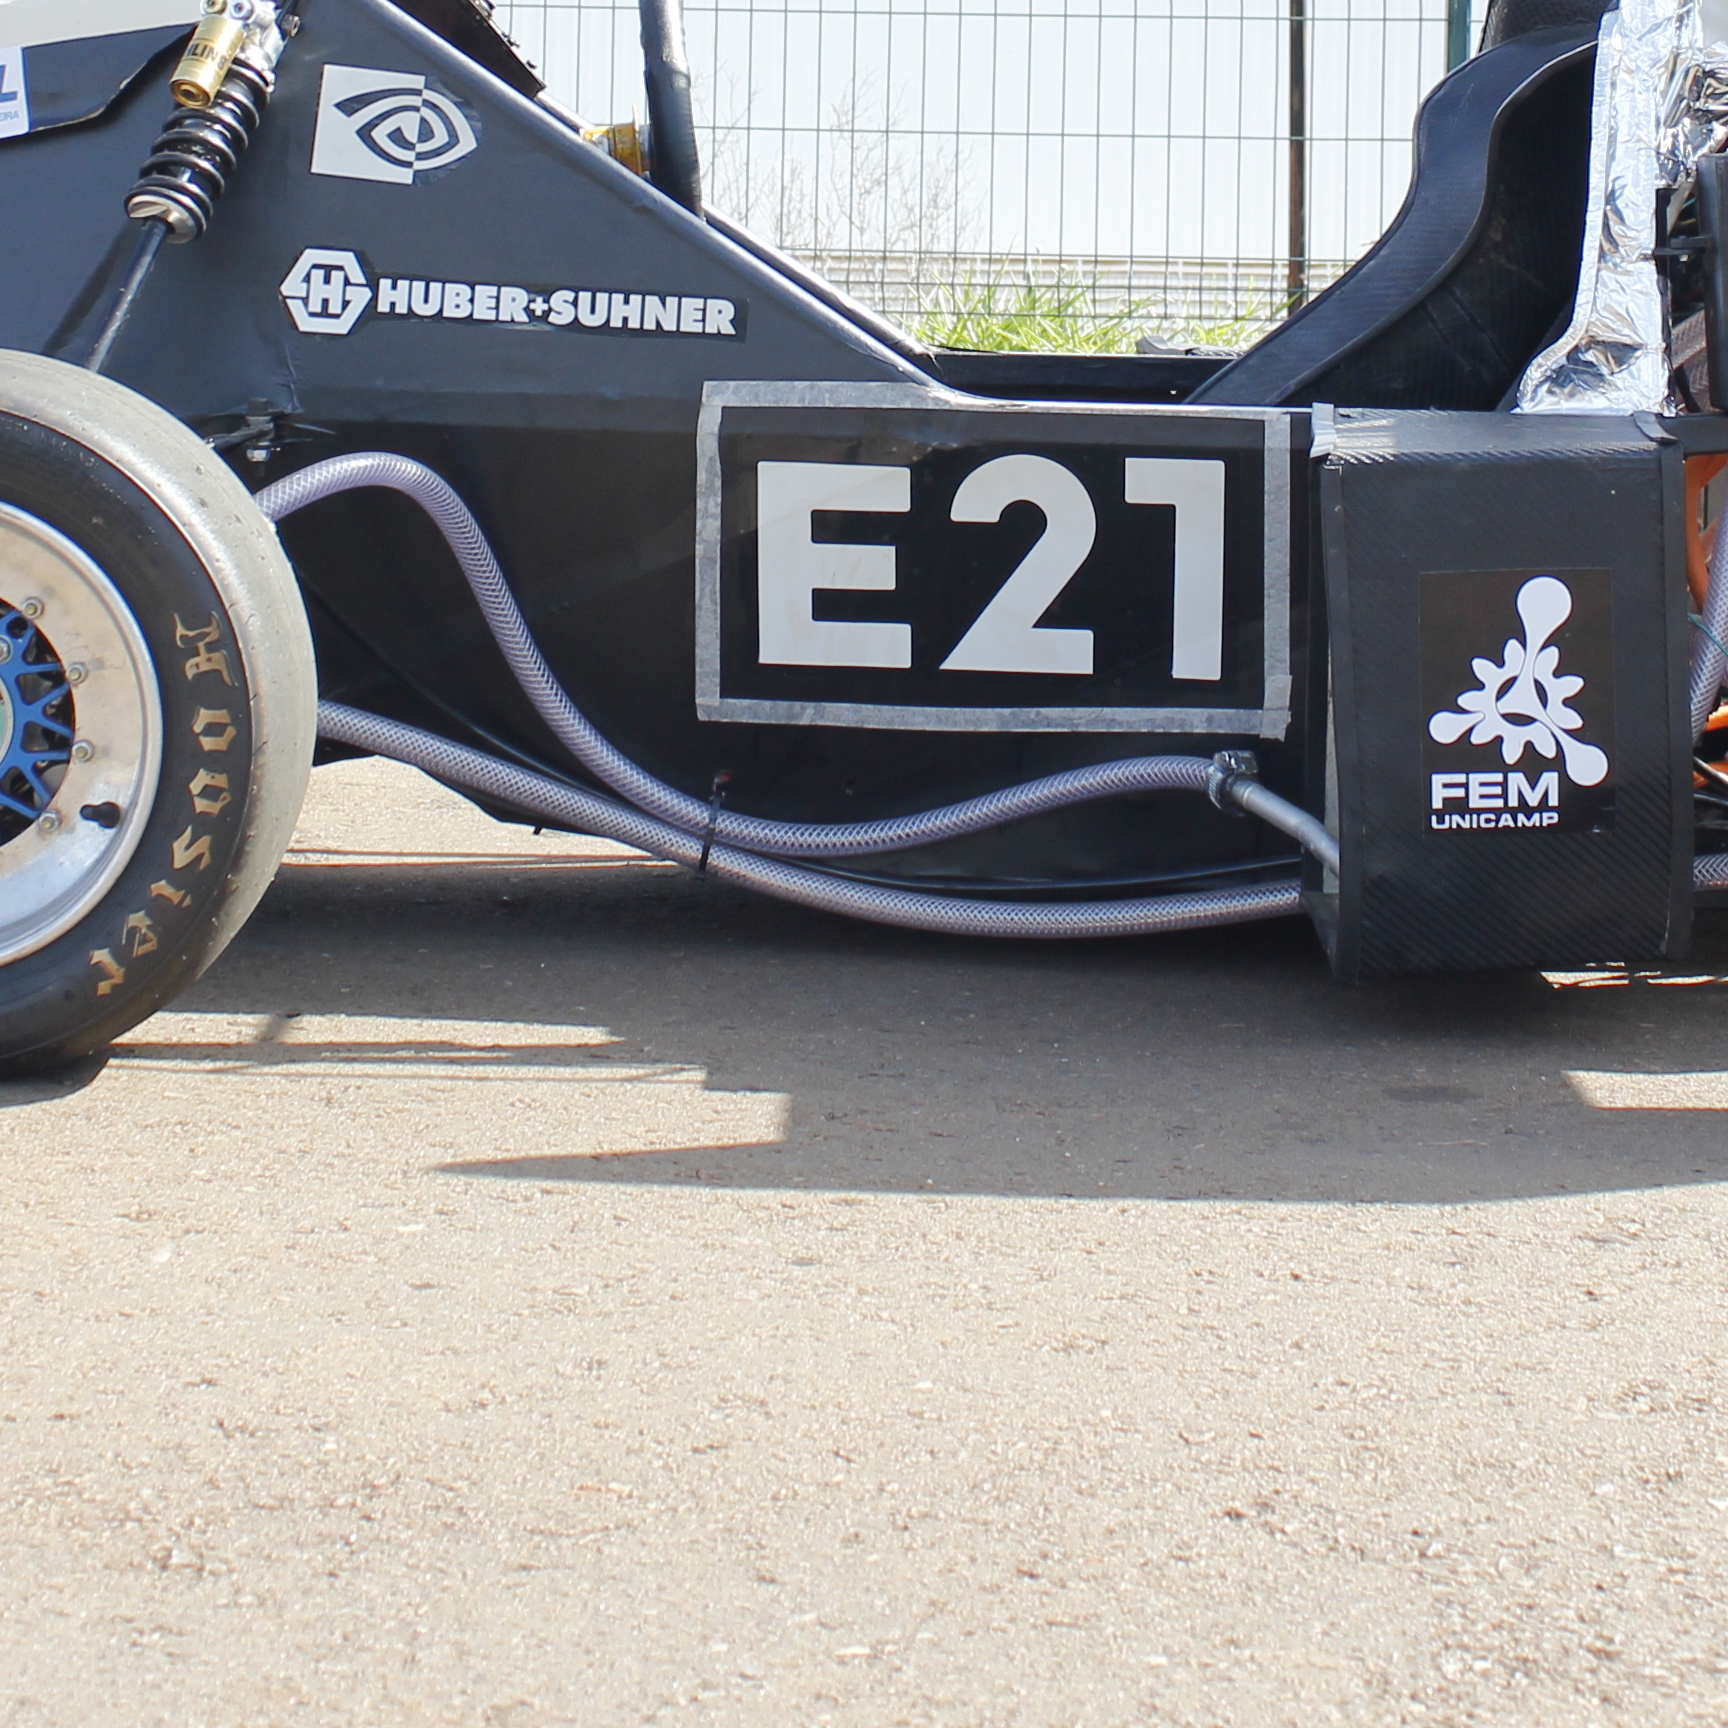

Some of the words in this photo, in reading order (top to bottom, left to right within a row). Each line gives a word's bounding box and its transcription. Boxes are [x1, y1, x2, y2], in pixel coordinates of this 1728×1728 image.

[376, 277, 737, 336] HUBER+SUHNER
[756, 453, 1227, 682] E21
[89, 610, 239, 998] Hoosier
[1430, 770, 1561, 810] FEM
[1430, 811, 1561, 829] UNICAMP
